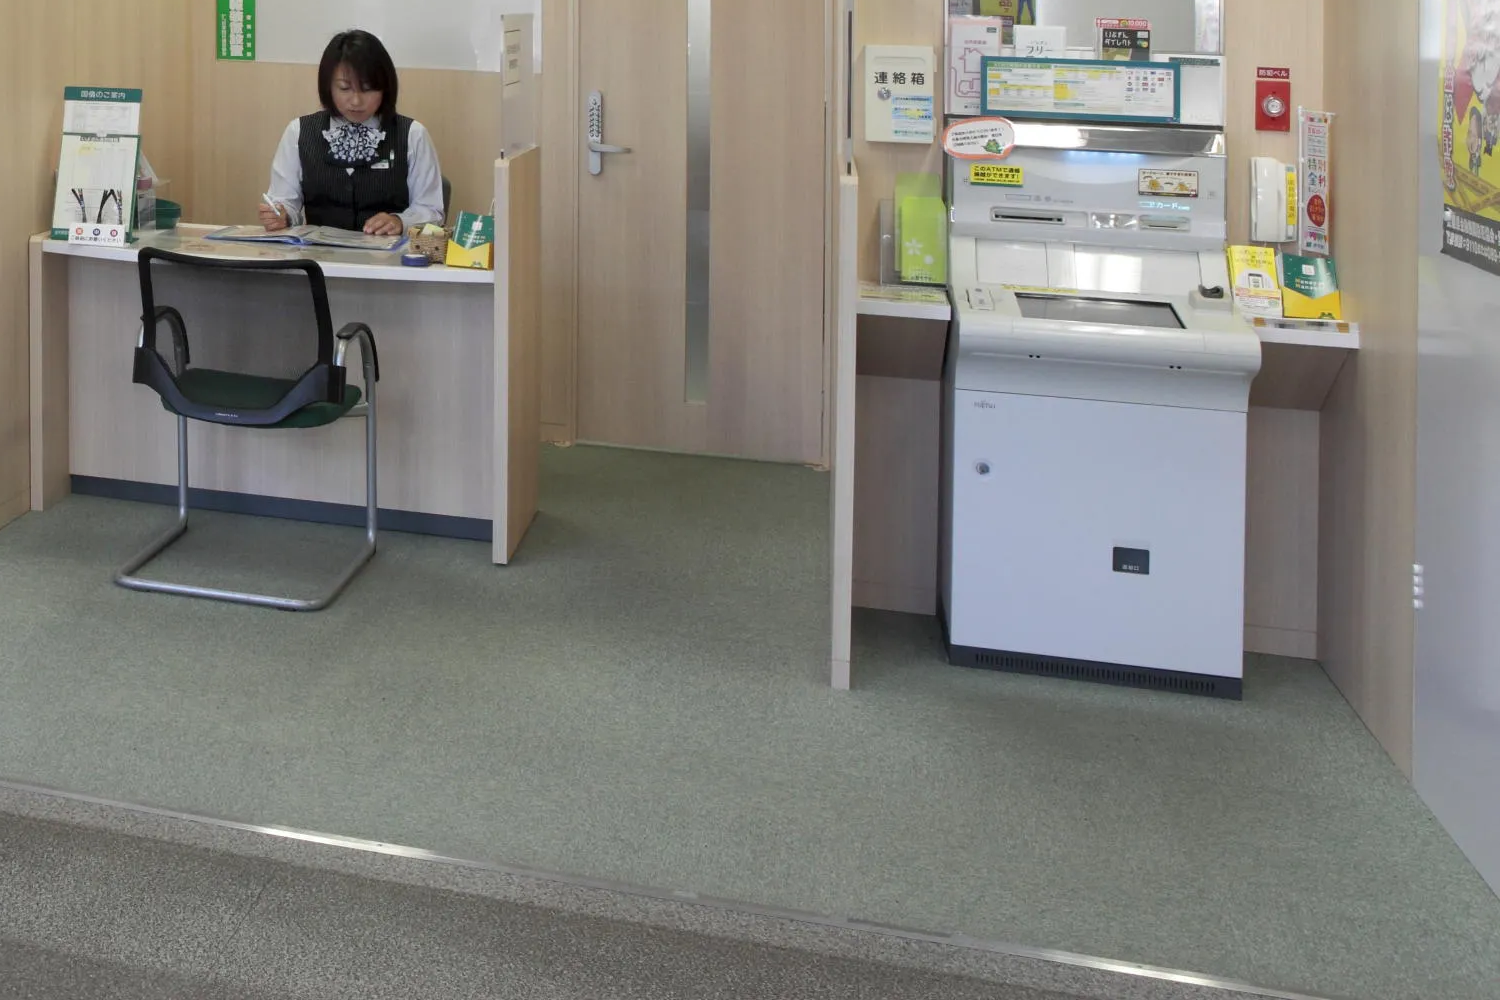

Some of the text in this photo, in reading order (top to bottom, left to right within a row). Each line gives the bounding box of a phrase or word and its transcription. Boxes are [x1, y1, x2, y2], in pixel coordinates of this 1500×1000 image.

[874, 71, 925, 85] 連絡箱
[1259, 69, 1288, 77] 防犯ベル
